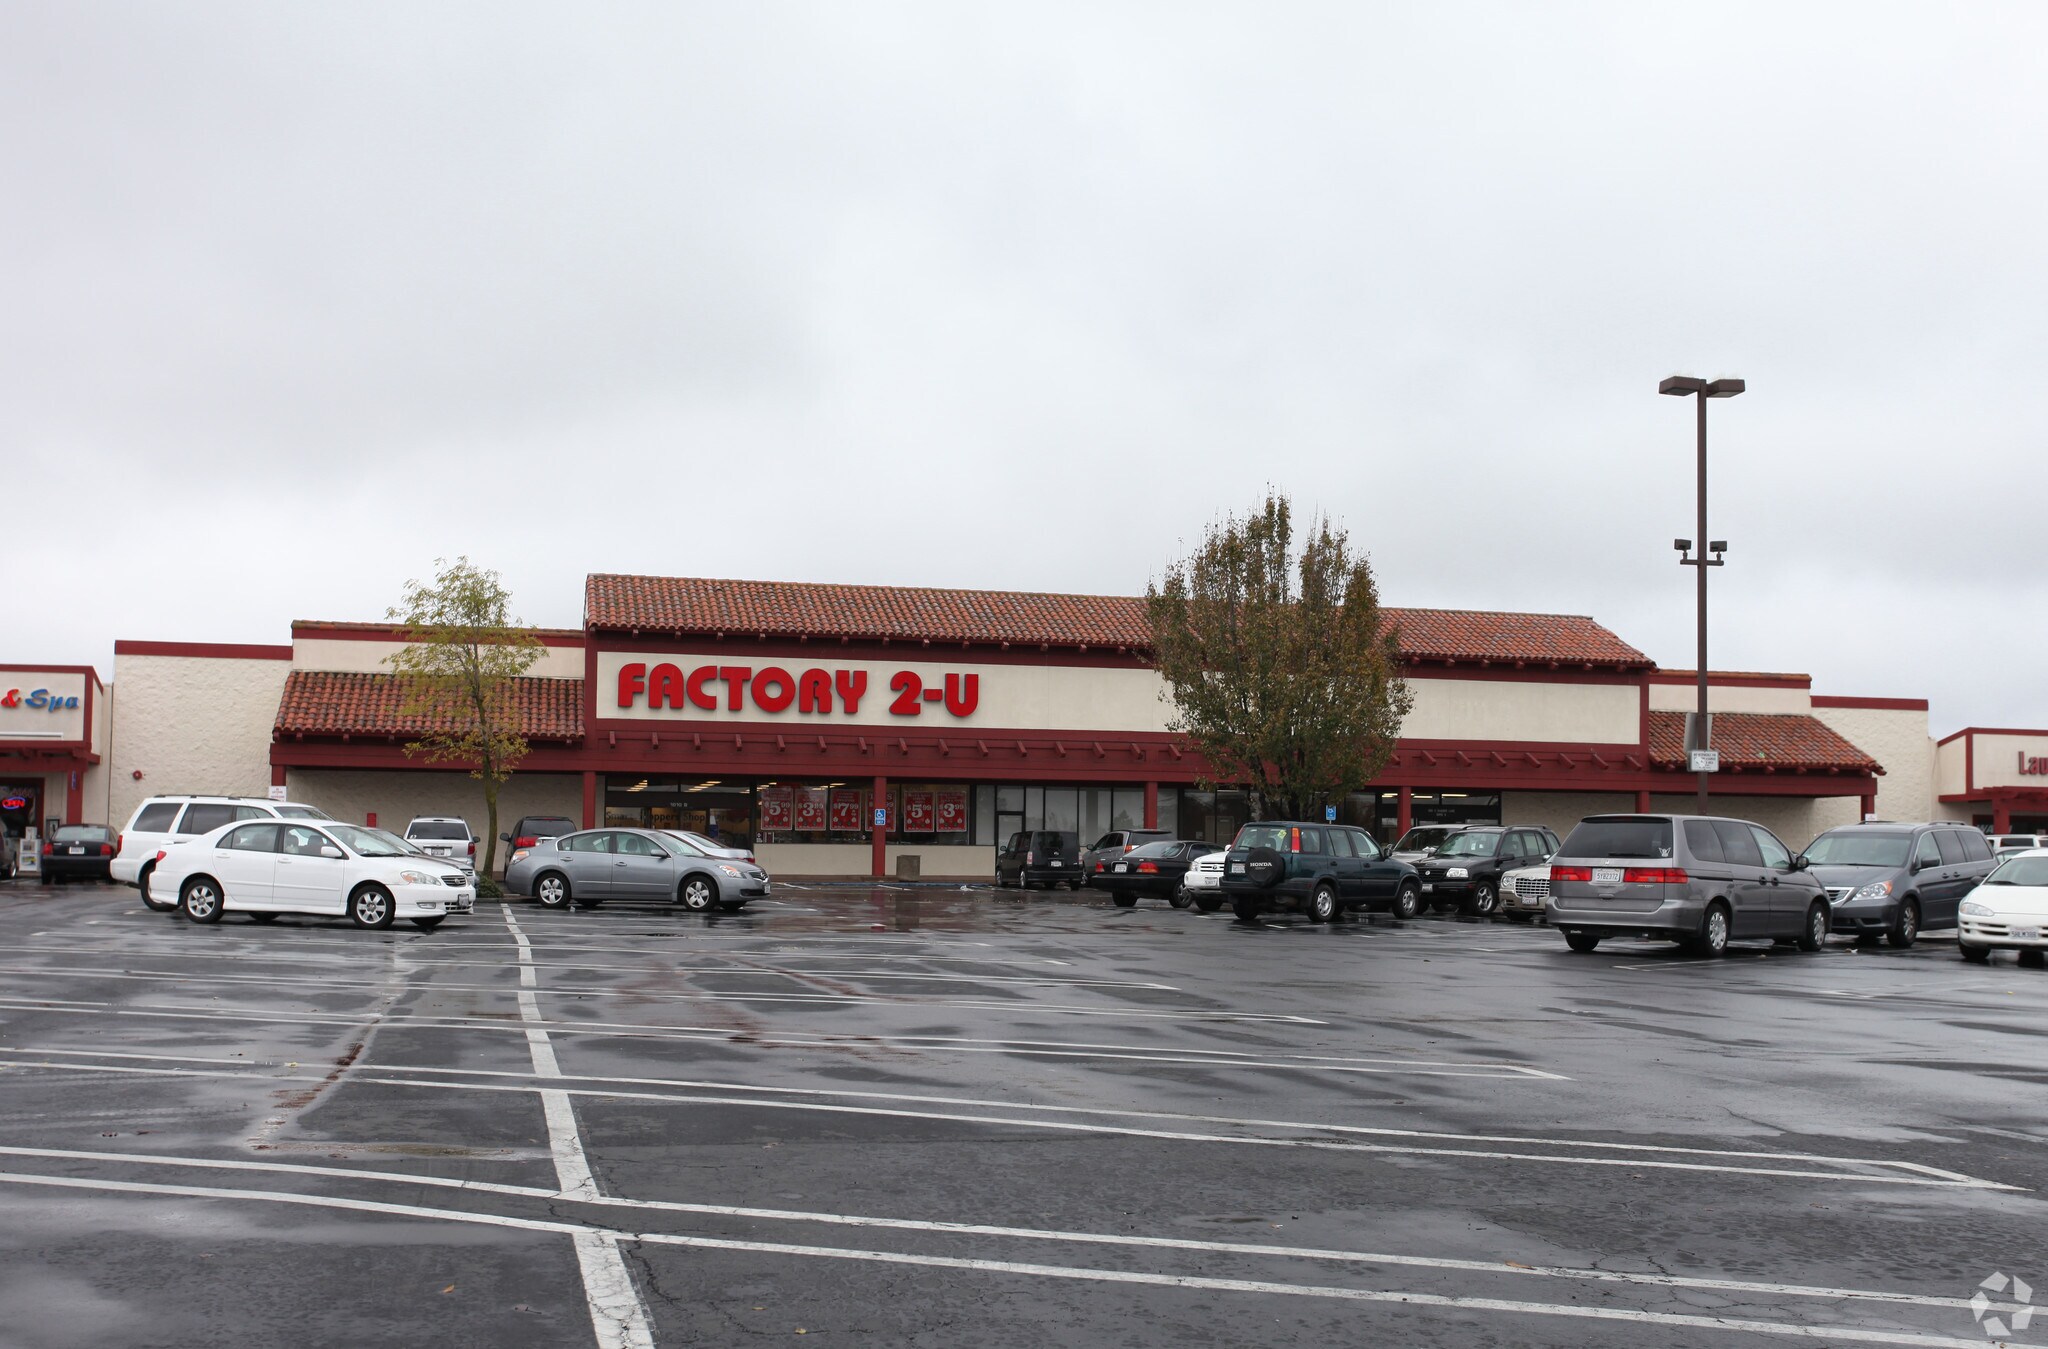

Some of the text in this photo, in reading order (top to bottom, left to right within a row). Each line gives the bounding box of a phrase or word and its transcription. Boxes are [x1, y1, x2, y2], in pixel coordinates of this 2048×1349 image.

[618, 663, 979, 717] FACTORY 2-U
[1, 689, 79, 713] & Spa
[2, 799, 25, 808] OPEN
[683, 812, 705, 824] Shop
